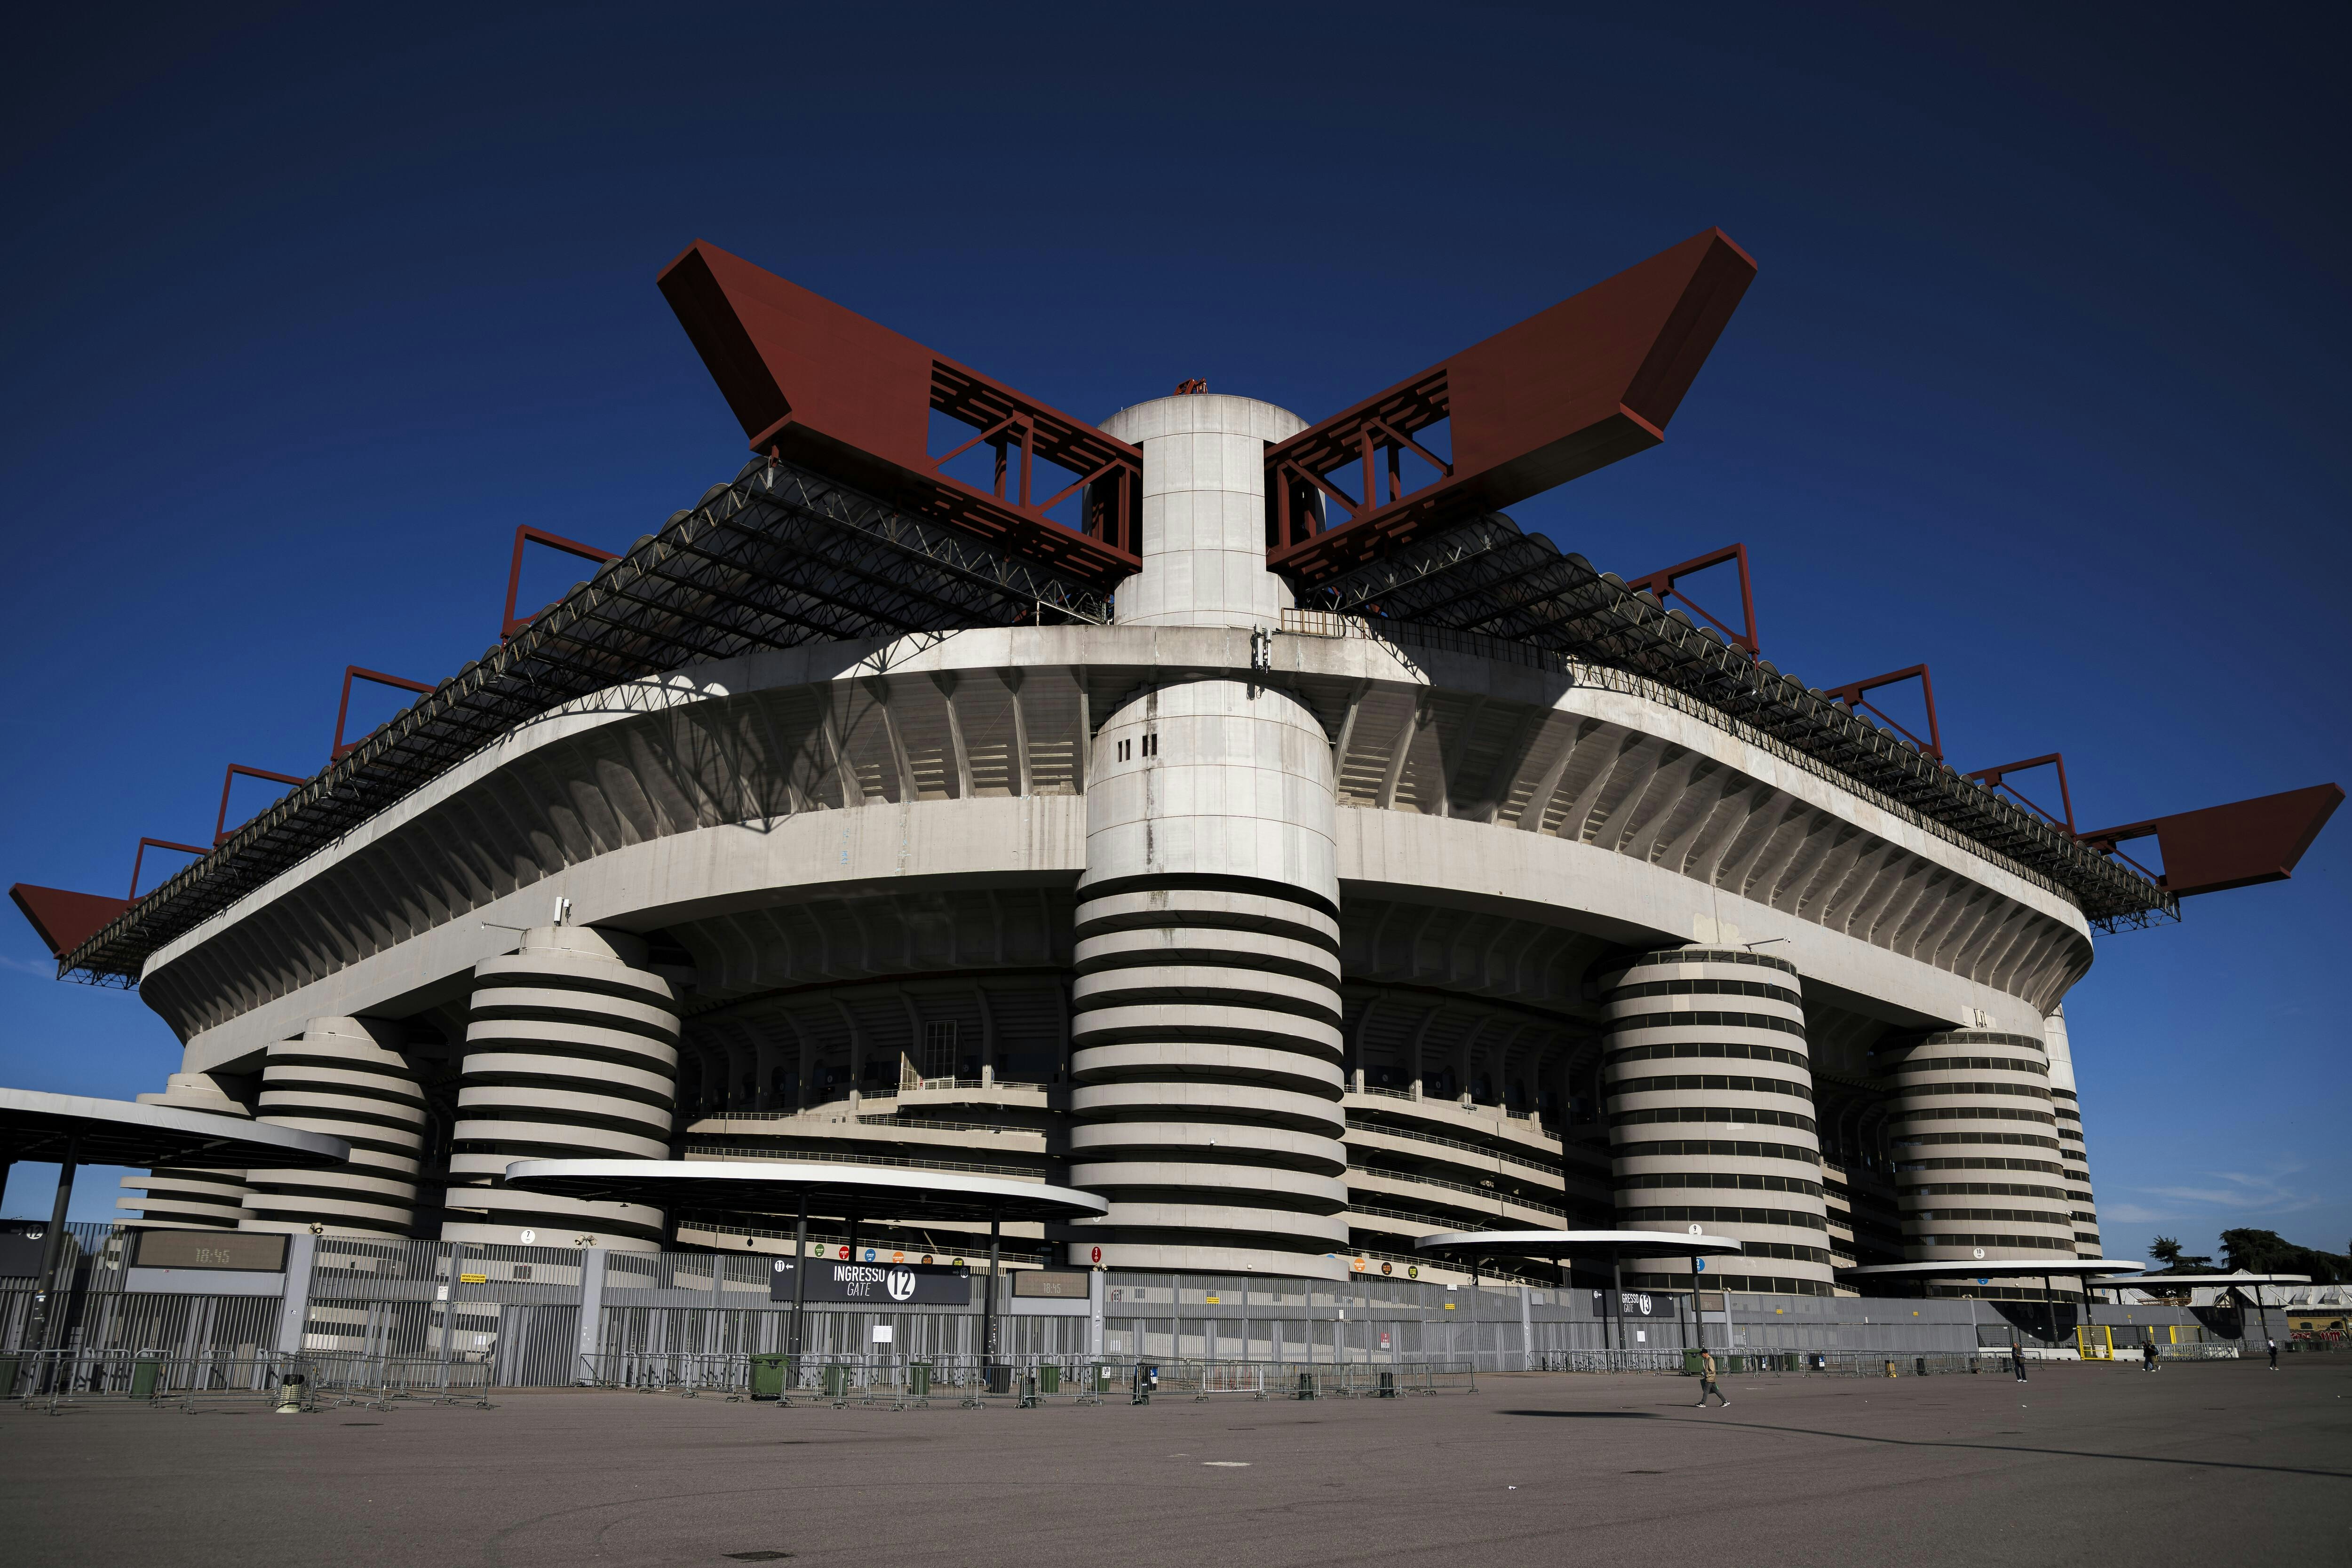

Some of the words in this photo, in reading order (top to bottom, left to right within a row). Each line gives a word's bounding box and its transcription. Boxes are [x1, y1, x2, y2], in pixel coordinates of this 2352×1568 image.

[29, 1226, 41, 1238] 12
[196, 1248, 230, 1264] 18:45
[776, 1261, 783, 1270] 11
[834, 1265, 885, 1282] INGRESSO
[891, 1269, 911, 1295] 12
[1043, 1283, 1061, 1294] 18:45
[847, 1282, 871, 1296] GATE
[1622, 1293, 1639, 1304] GRESSO
[1641, 1295, 1650, 1312] 13
[1624, 1303, 1634, 1313] GATE
